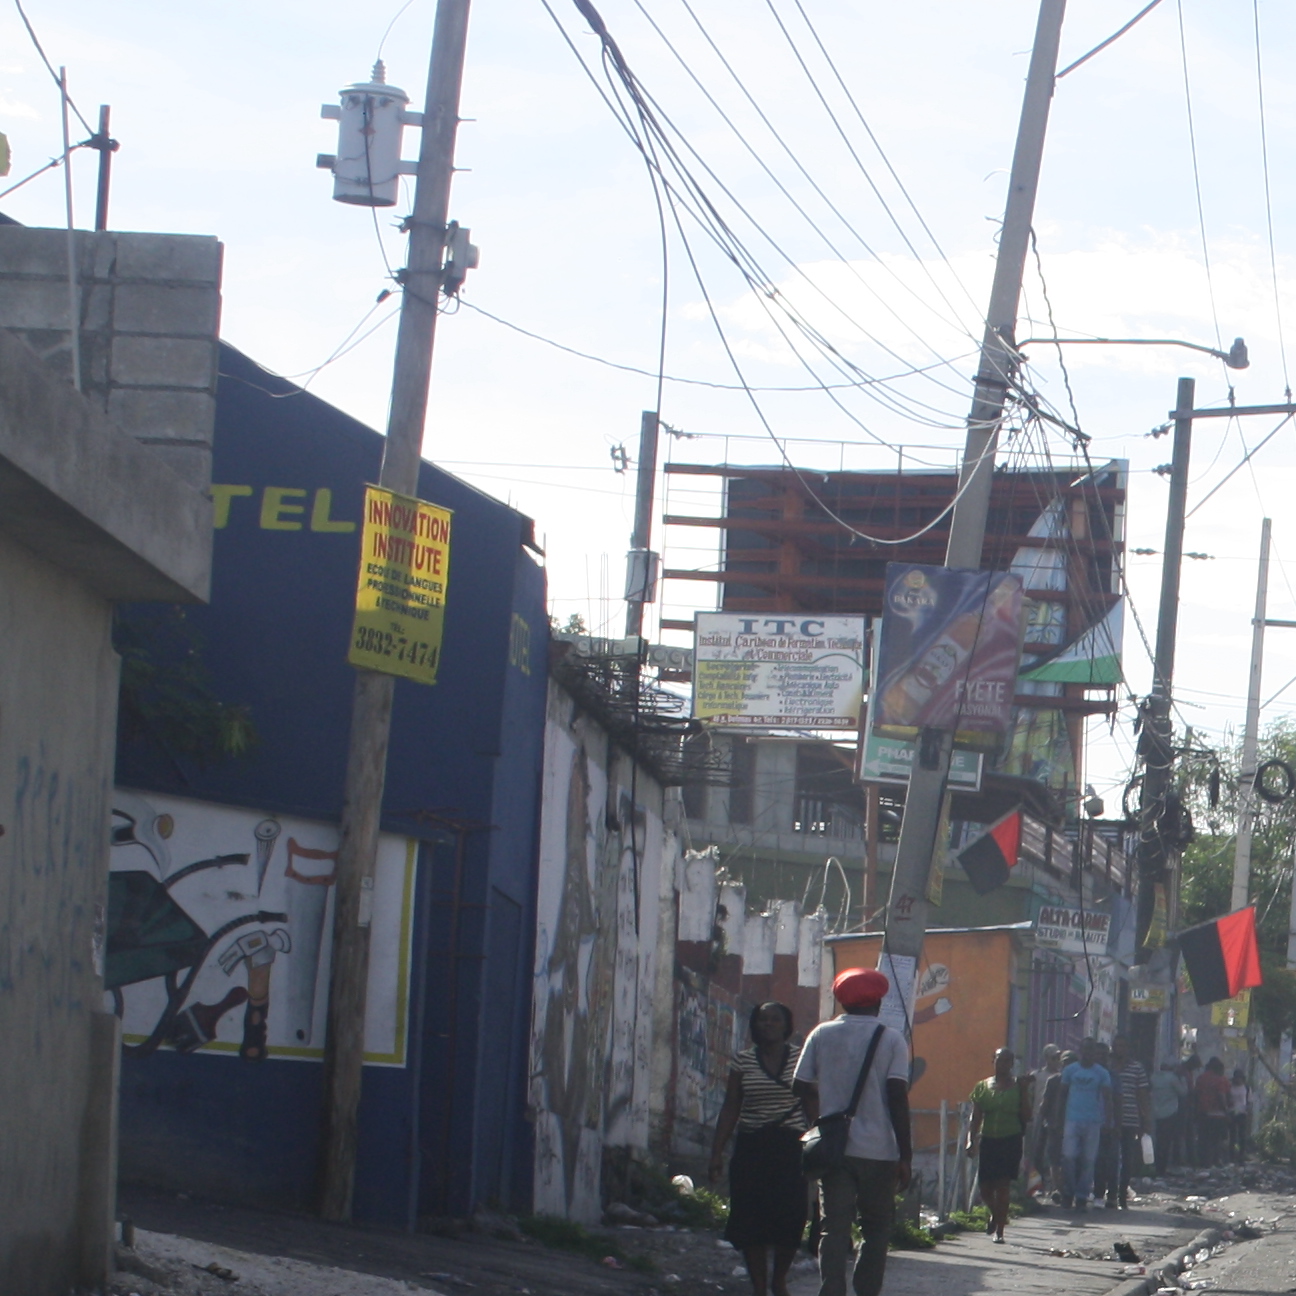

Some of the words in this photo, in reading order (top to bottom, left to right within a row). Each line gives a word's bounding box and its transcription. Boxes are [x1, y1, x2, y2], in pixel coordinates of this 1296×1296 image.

[211, 484, 356, 533] TEL
[369, 499, 450, 545] INNOVATION
[373, 531, 441, 576] INSTITUTE
[367, 578, 441, 609] PROFESSIONNELLE
[404, 575, 443, 594] LANGUES
[381, 597, 430, 621] TECHNIQUE
[894, 595, 935, 607] BAKARA
[738, 619, 825, 637] ITC
[355, 626, 440, 670] 3832-7474
